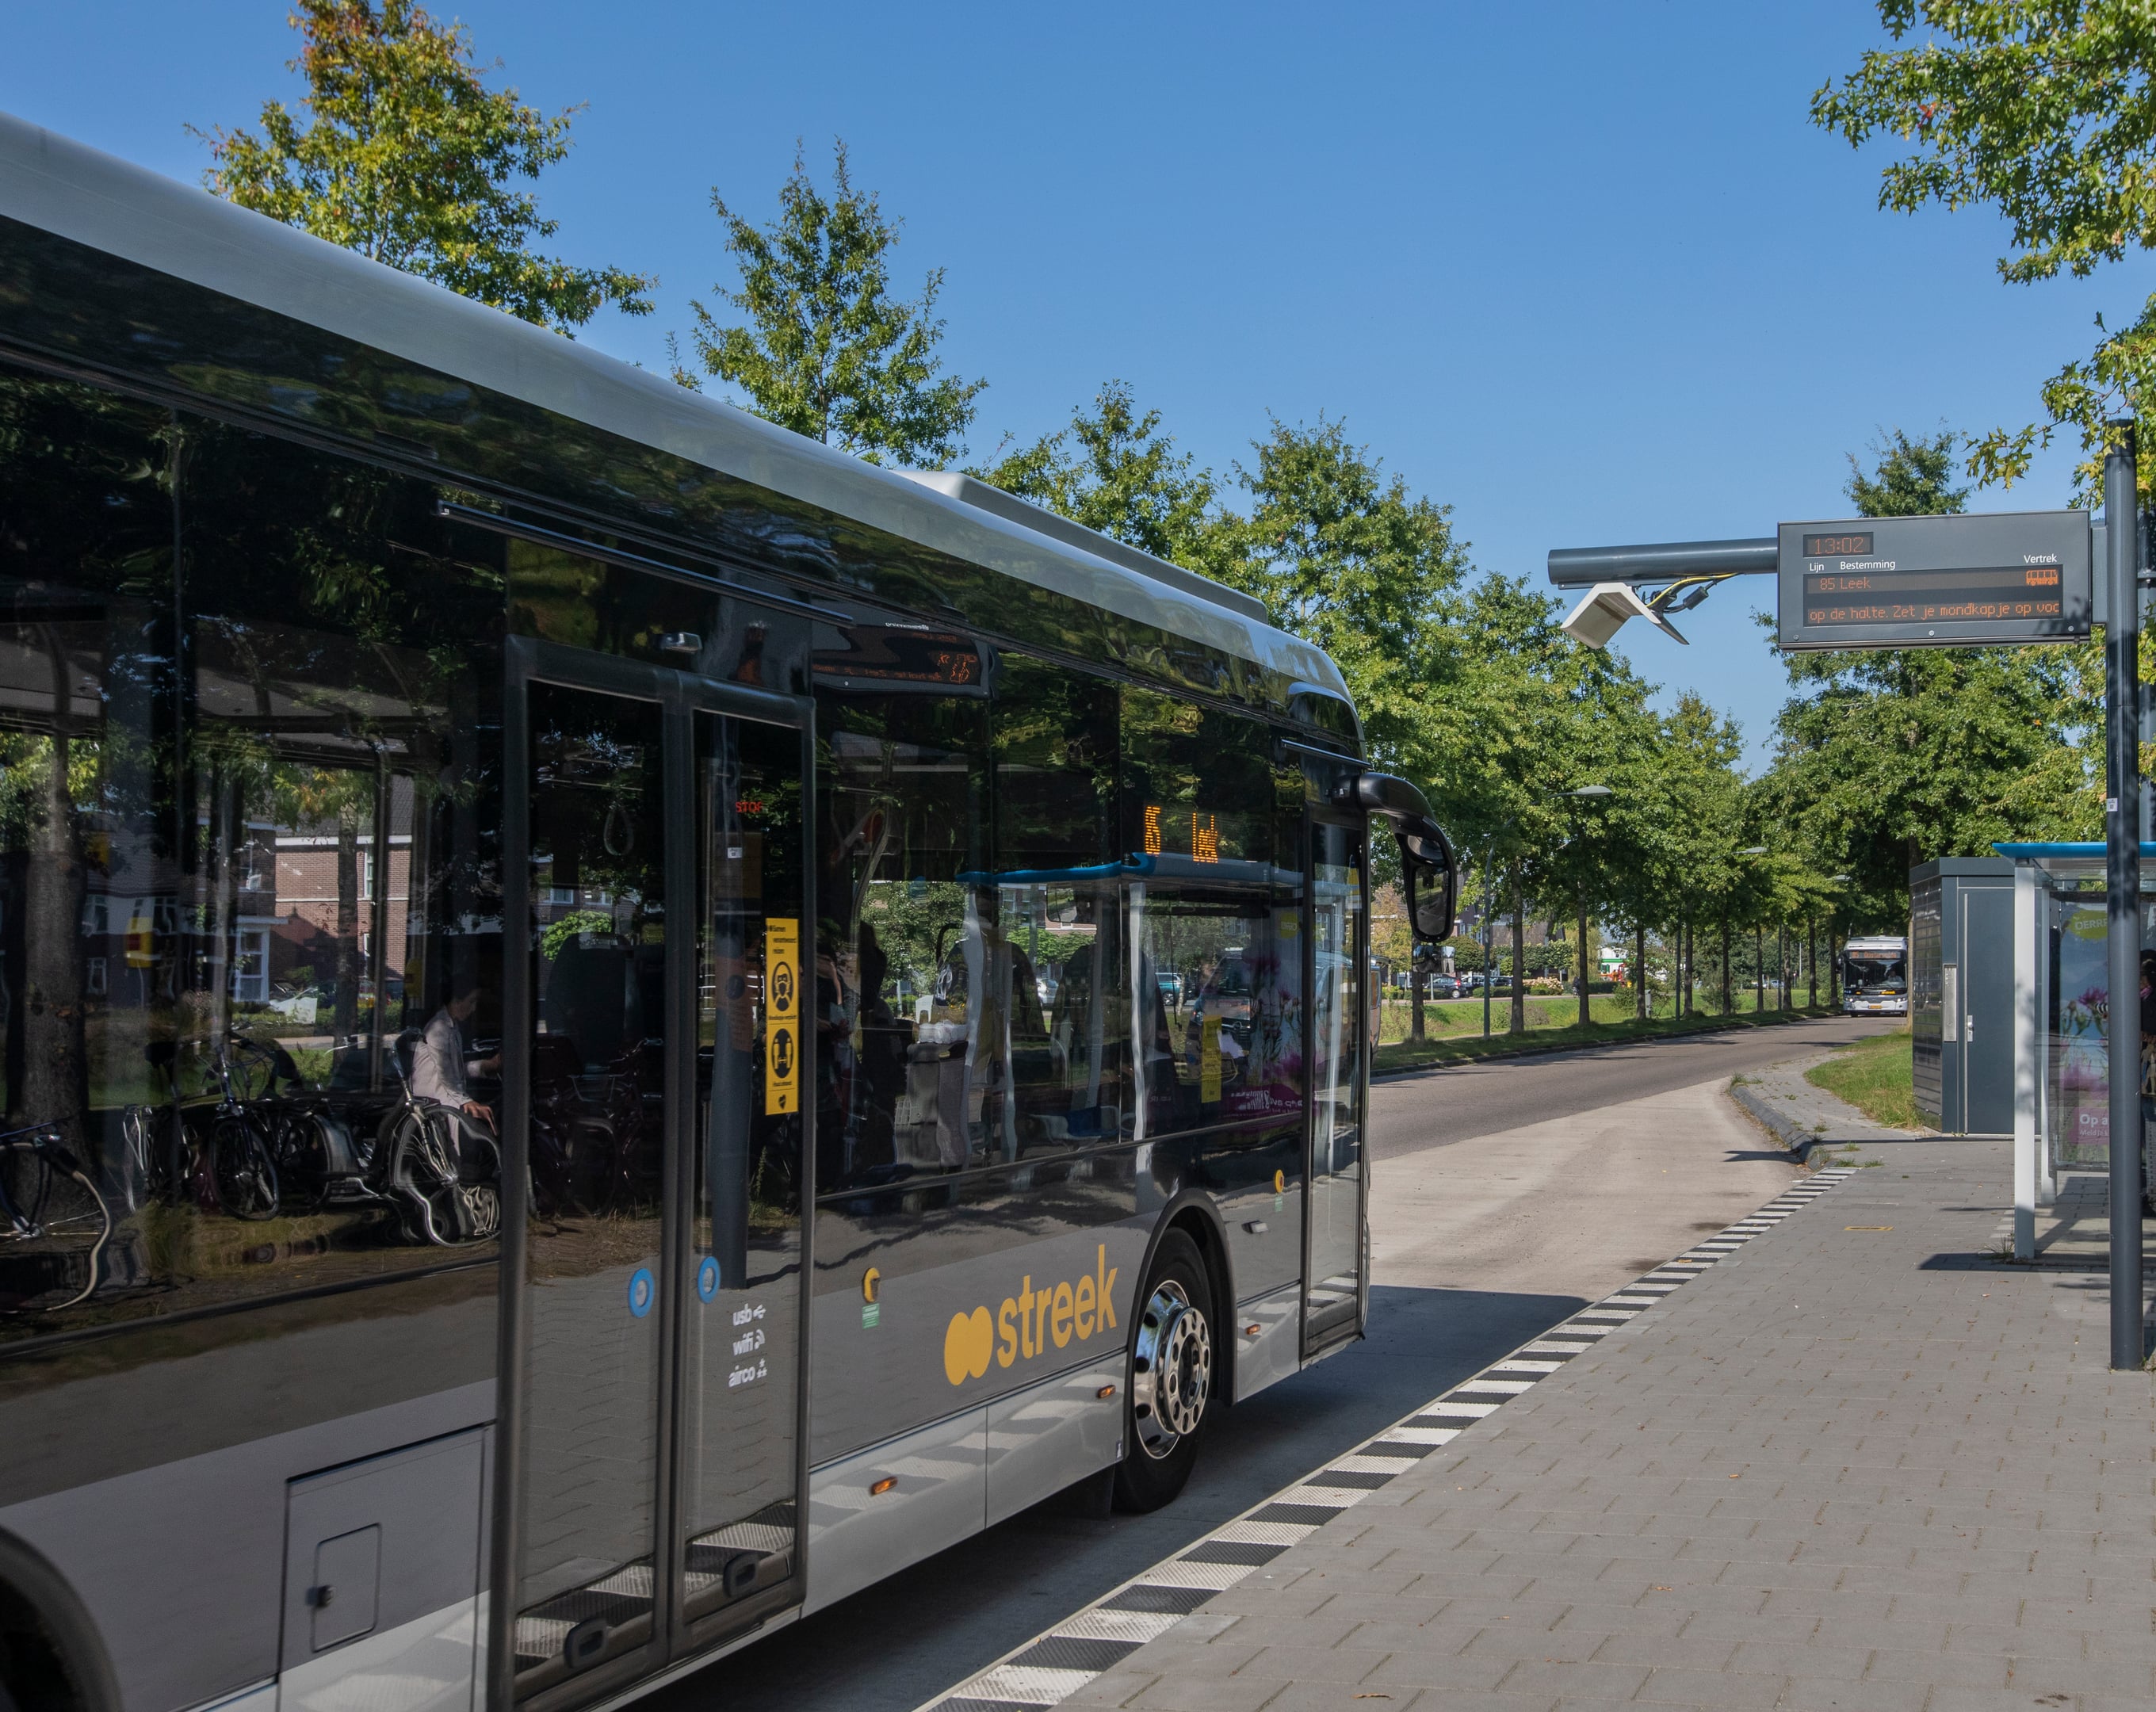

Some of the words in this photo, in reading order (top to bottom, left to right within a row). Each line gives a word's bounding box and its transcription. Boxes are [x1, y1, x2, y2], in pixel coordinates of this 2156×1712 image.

[1814, 537, 1864, 555] 13:02
[1809, 562, 1825, 573] Lijn
[1840, 560, 1896, 571] Bestemming
[2023, 553, 2058, 564] Vertrek
[1820, 577, 1836, 590] 85
[1840, 576, 1871, 590] Leek
[1809, 610, 1825, 624] op
[1830, 608, 1846, 620] de
[1851, 606, 1889, 619] halte.
[1893, 605, 1916, 618] Zet
[1921, 606, 1935, 621] je
[1940, 602, 2010, 618] mondkapje
[2015, 602, 2032, 617] op
[2080, 1114, 2099, 1128] Op
[732, 1303, 752, 1326] usb
[996, 1244, 1118, 1368] streek
[732, 1332, 754, 1356] wifi
[728, 1365, 755, 1387] airco
